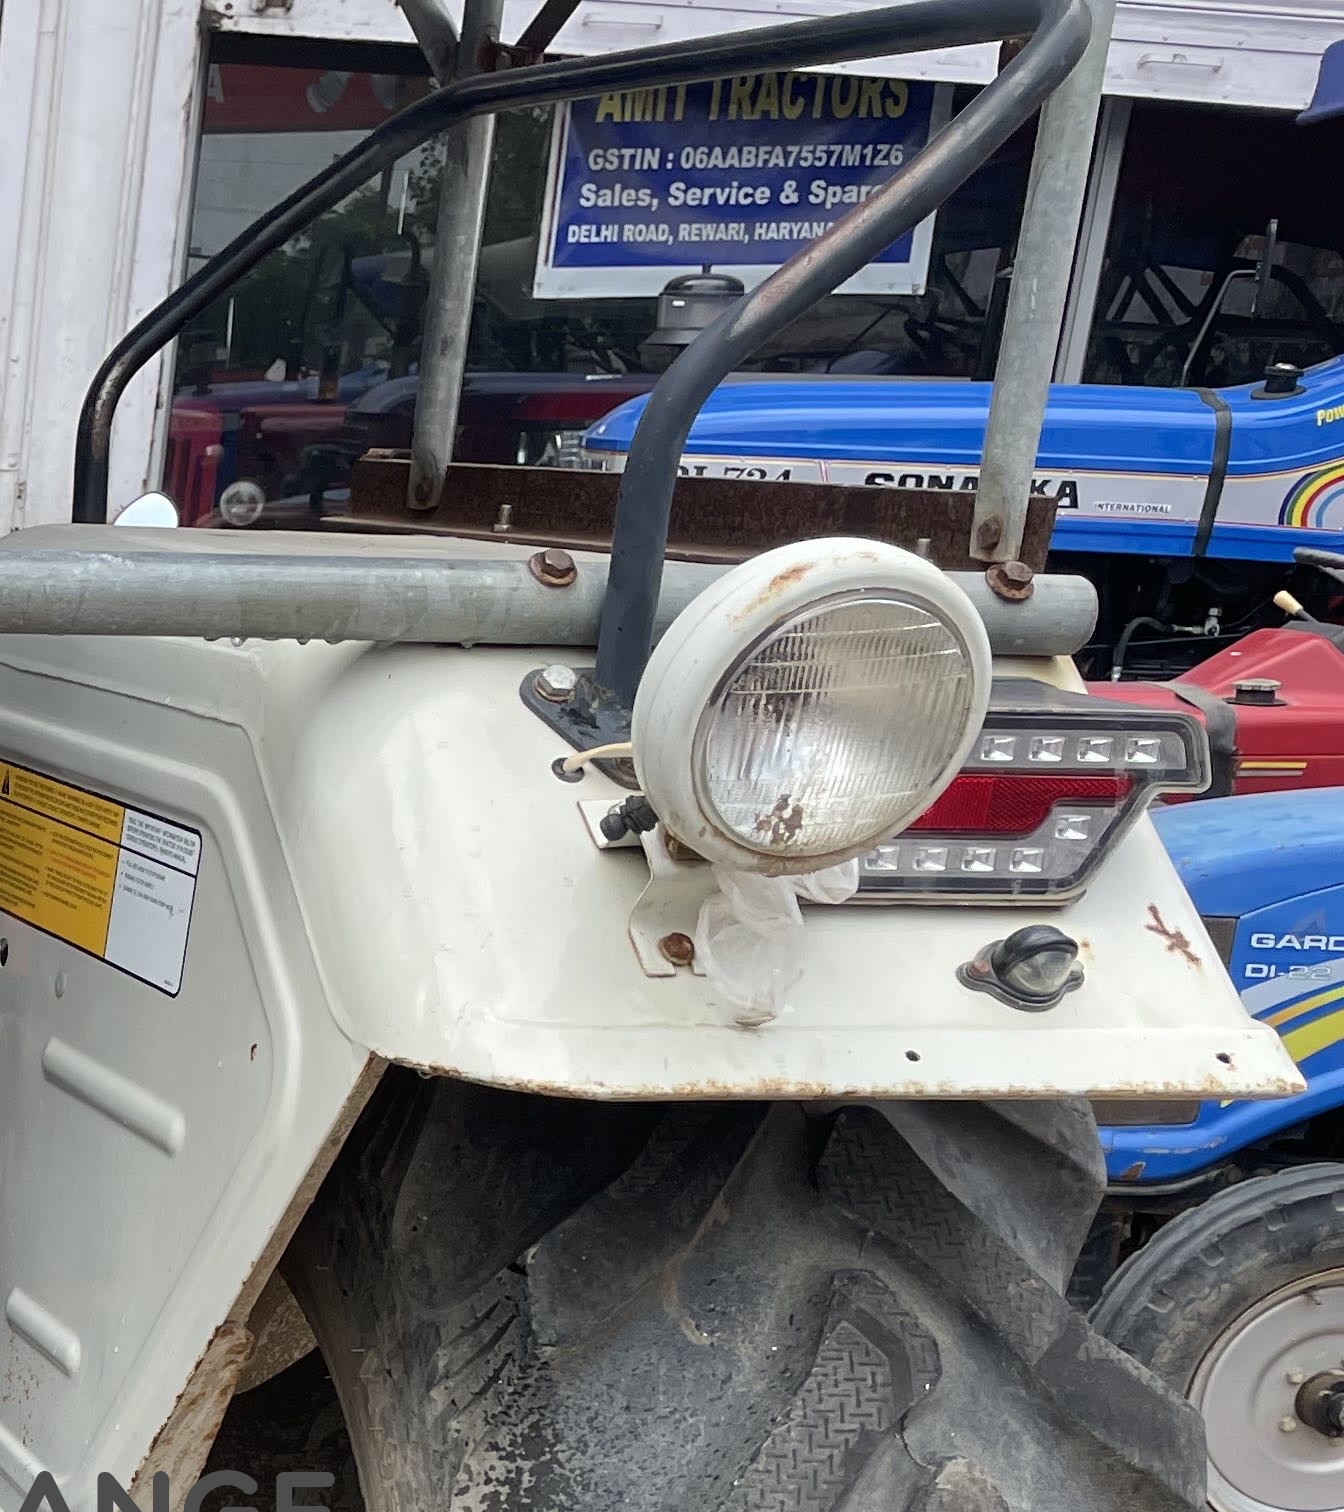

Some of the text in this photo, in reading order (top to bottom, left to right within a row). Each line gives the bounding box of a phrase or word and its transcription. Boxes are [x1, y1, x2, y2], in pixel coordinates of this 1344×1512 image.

[708, 73, 909, 122] TRACTORS
[588, 147, 660, 172] GSTIN
[579, 179, 883, 212] Sales, Service & Spar
[567, 223, 618, 244] DELHI
[623, 223, 674, 247] ROAD,
[678, 221, 750, 245] REWARI,
[1094, 503, 1170, 514] INTERNATIONAL
[1244, 963, 1333, 982] DI-22
